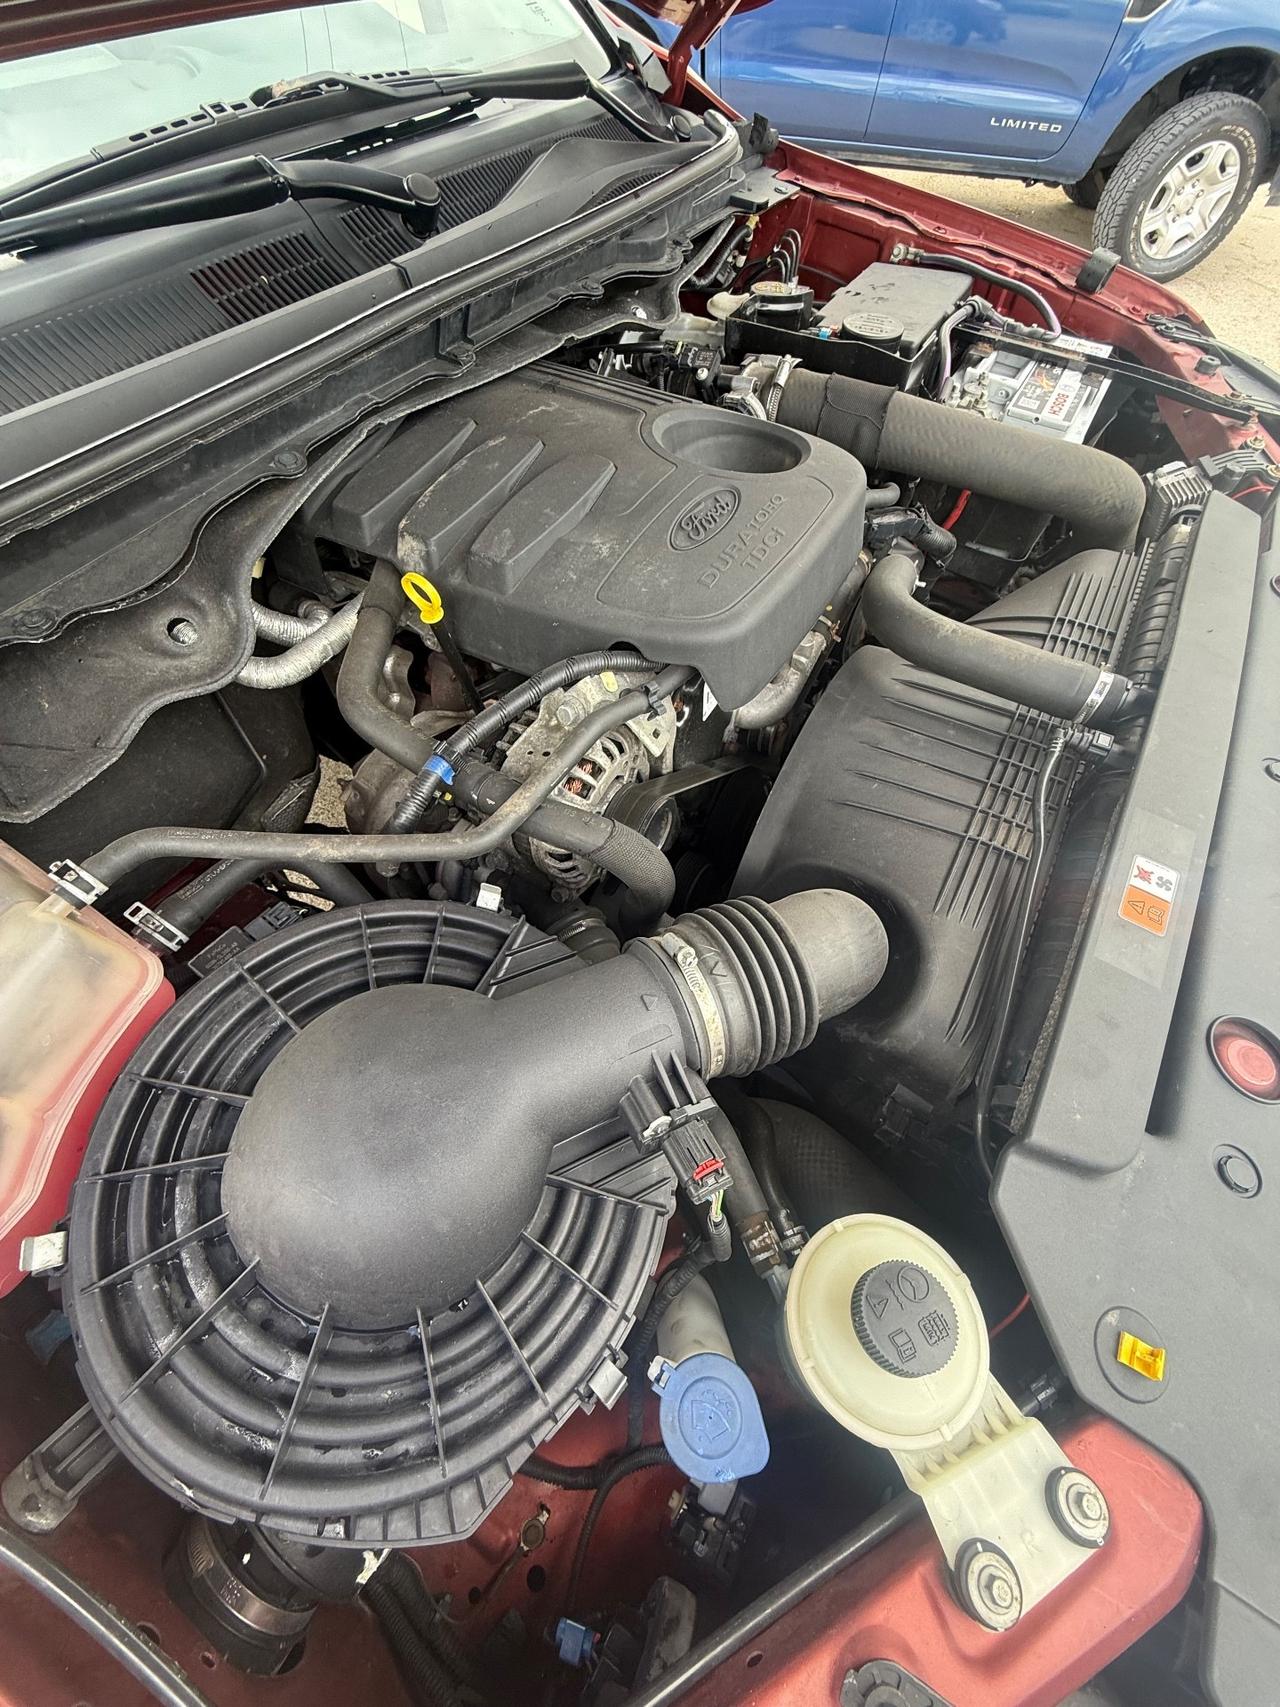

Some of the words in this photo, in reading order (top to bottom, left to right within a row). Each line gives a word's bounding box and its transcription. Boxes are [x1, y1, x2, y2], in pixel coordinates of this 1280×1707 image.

[990, 117, 1062, 133] LIMITED
[1047, 392, 1069, 416] BOSCH
[681, 495, 732, 542] Ford
[698, 493, 785, 589] DURATORQ
